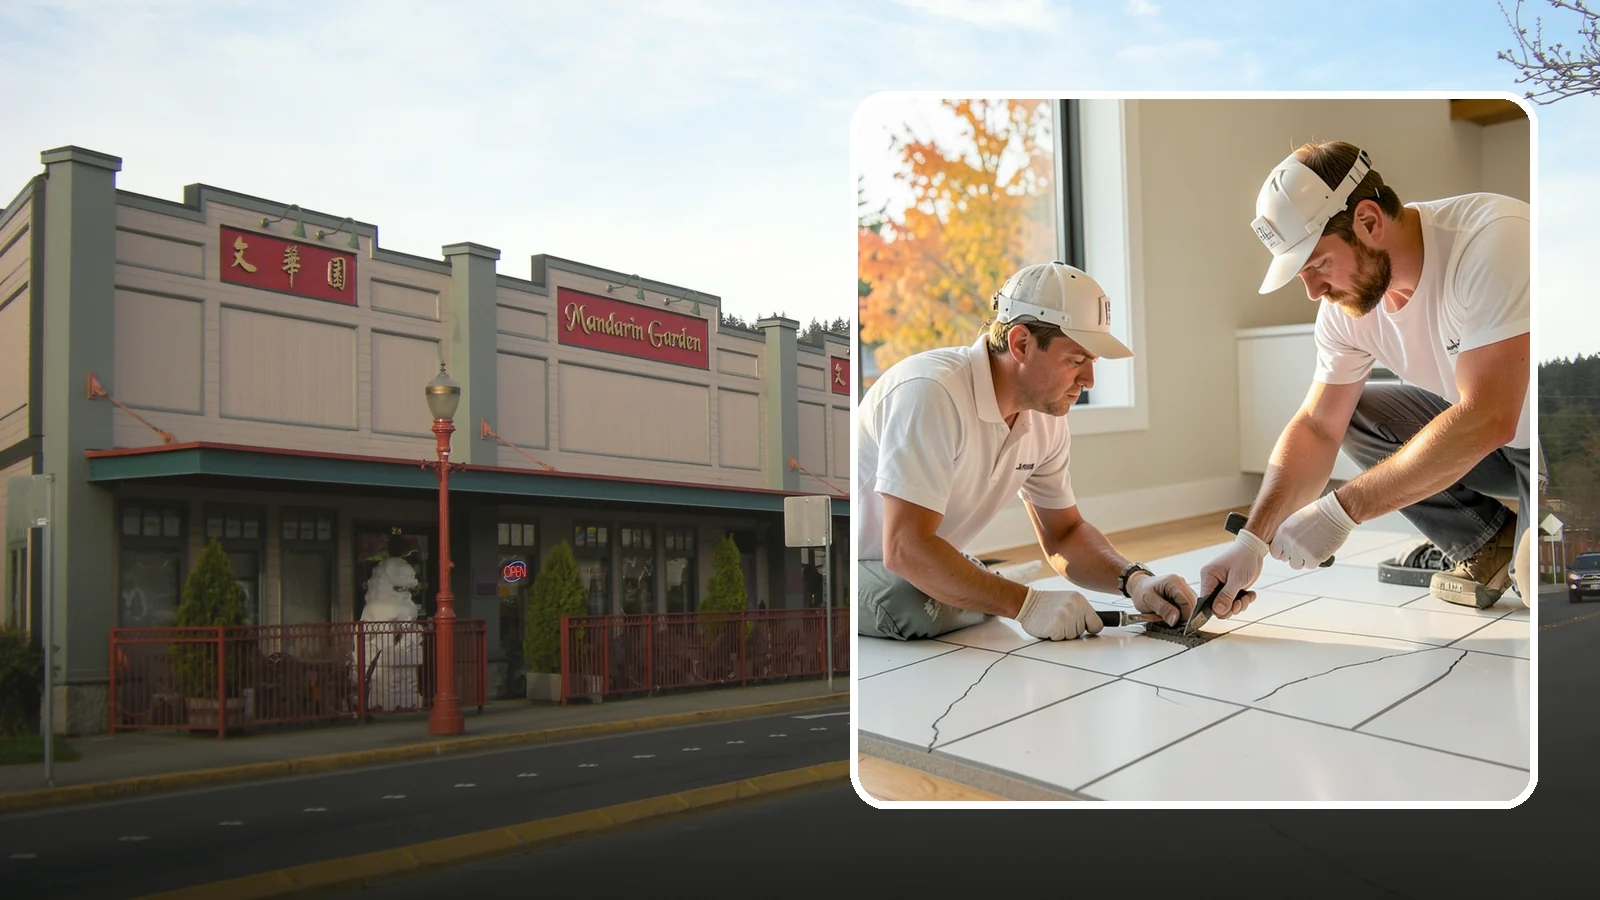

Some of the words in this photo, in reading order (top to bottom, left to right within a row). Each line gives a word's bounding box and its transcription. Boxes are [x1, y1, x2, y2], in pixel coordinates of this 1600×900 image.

[230, 236, 347, 291] 文華園
[564, 302, 644, 341] Mandarin
[648, 320, 701, 352] Garden
[503, 565, 527, 578] OPEN
